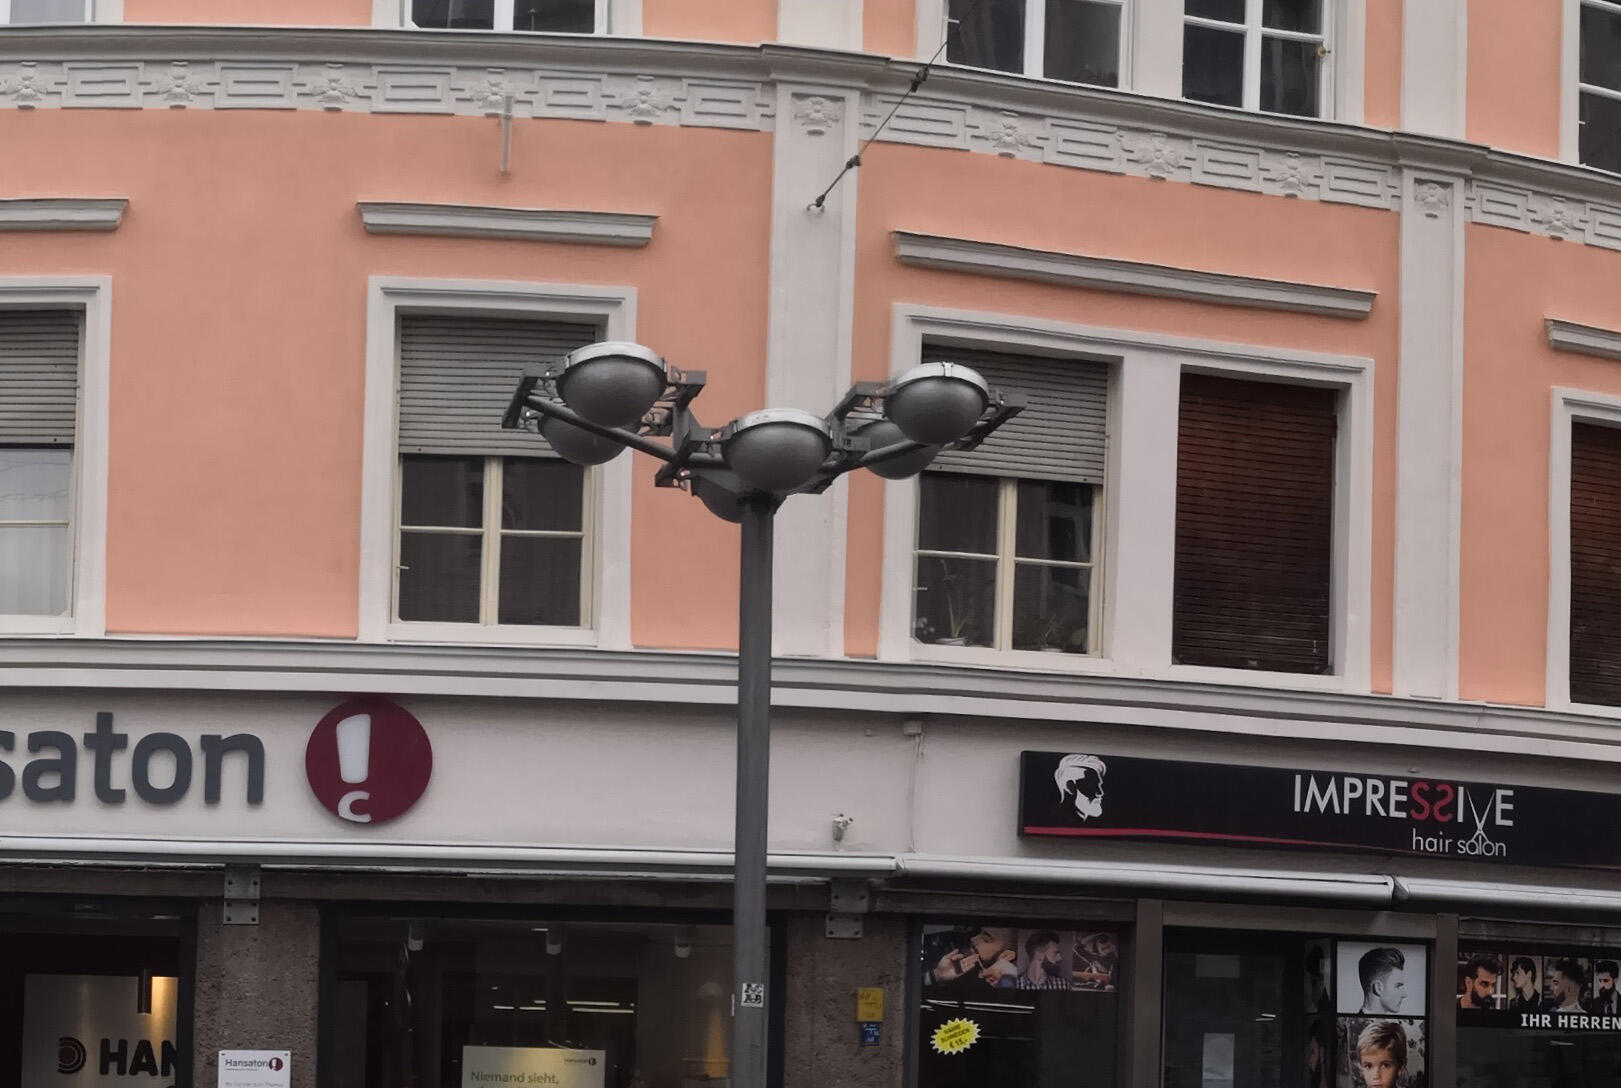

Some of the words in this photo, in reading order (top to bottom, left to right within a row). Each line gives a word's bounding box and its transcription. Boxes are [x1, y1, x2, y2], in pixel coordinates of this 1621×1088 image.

[1293, 773, 1515, 828] IMPRESSIVE
[1412, 827, 1453, 854] hair
[1456, 834, 1507, 857] salon
[1520, 1013, 1552, 1028] IHR
[224, 1057, 268, 1068] Hansaton
[470, 1071, 525, 1084] Niemand
[527, 1071, 560, 1085] sieht,
